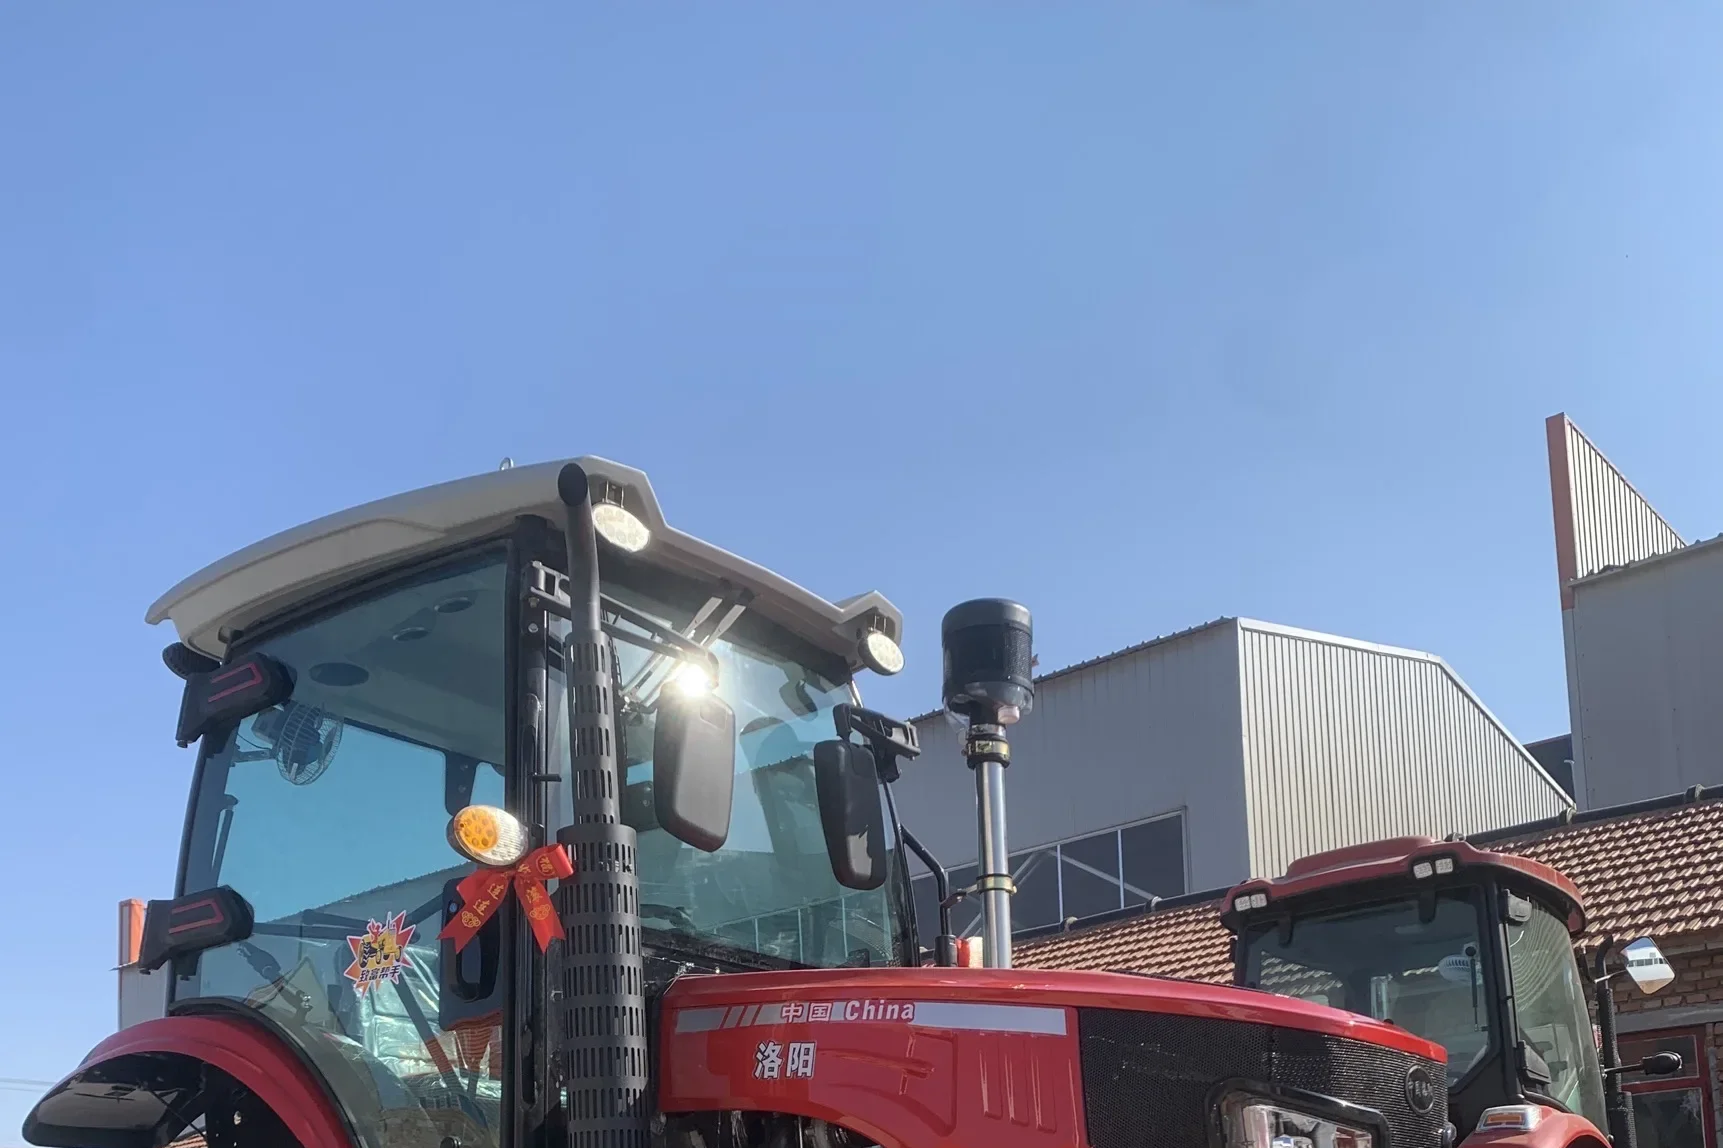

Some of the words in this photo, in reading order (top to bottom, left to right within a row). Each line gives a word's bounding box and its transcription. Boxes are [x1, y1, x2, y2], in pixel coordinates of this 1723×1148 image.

[359, 965, 401, 982] 致富帮手
[781, 1002, 832, 1023] 中国
[843, 999, 915, 1022] China
[753, 1041, 816, 1079] 洛阳
